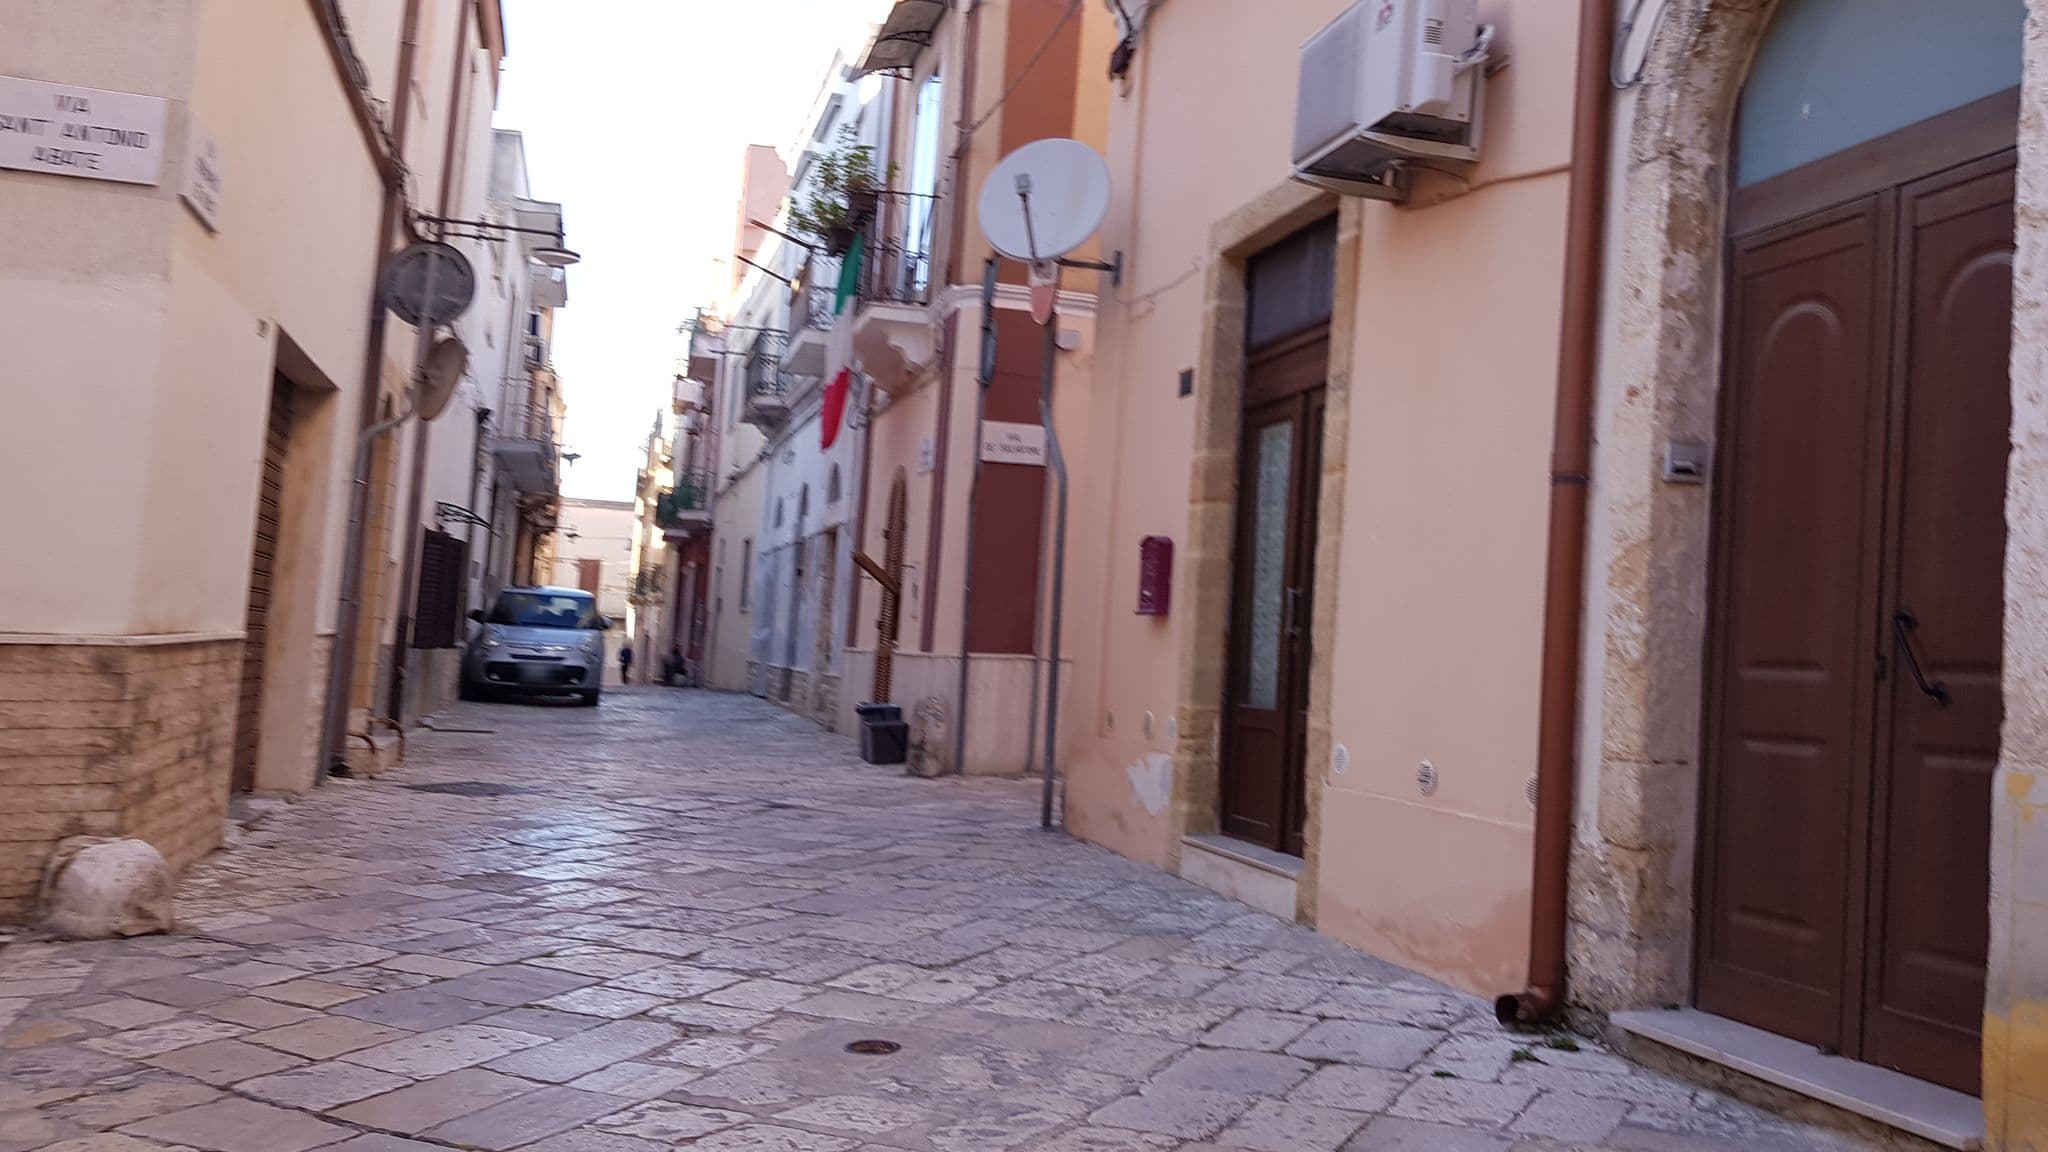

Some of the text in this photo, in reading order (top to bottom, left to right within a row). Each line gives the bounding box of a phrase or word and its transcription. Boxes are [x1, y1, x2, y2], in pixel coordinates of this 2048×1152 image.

[53, 94, 91, 114] VIA
[59, 121, 151, 149] ANTONIO
[31, 145, 104, 171] ABATE
